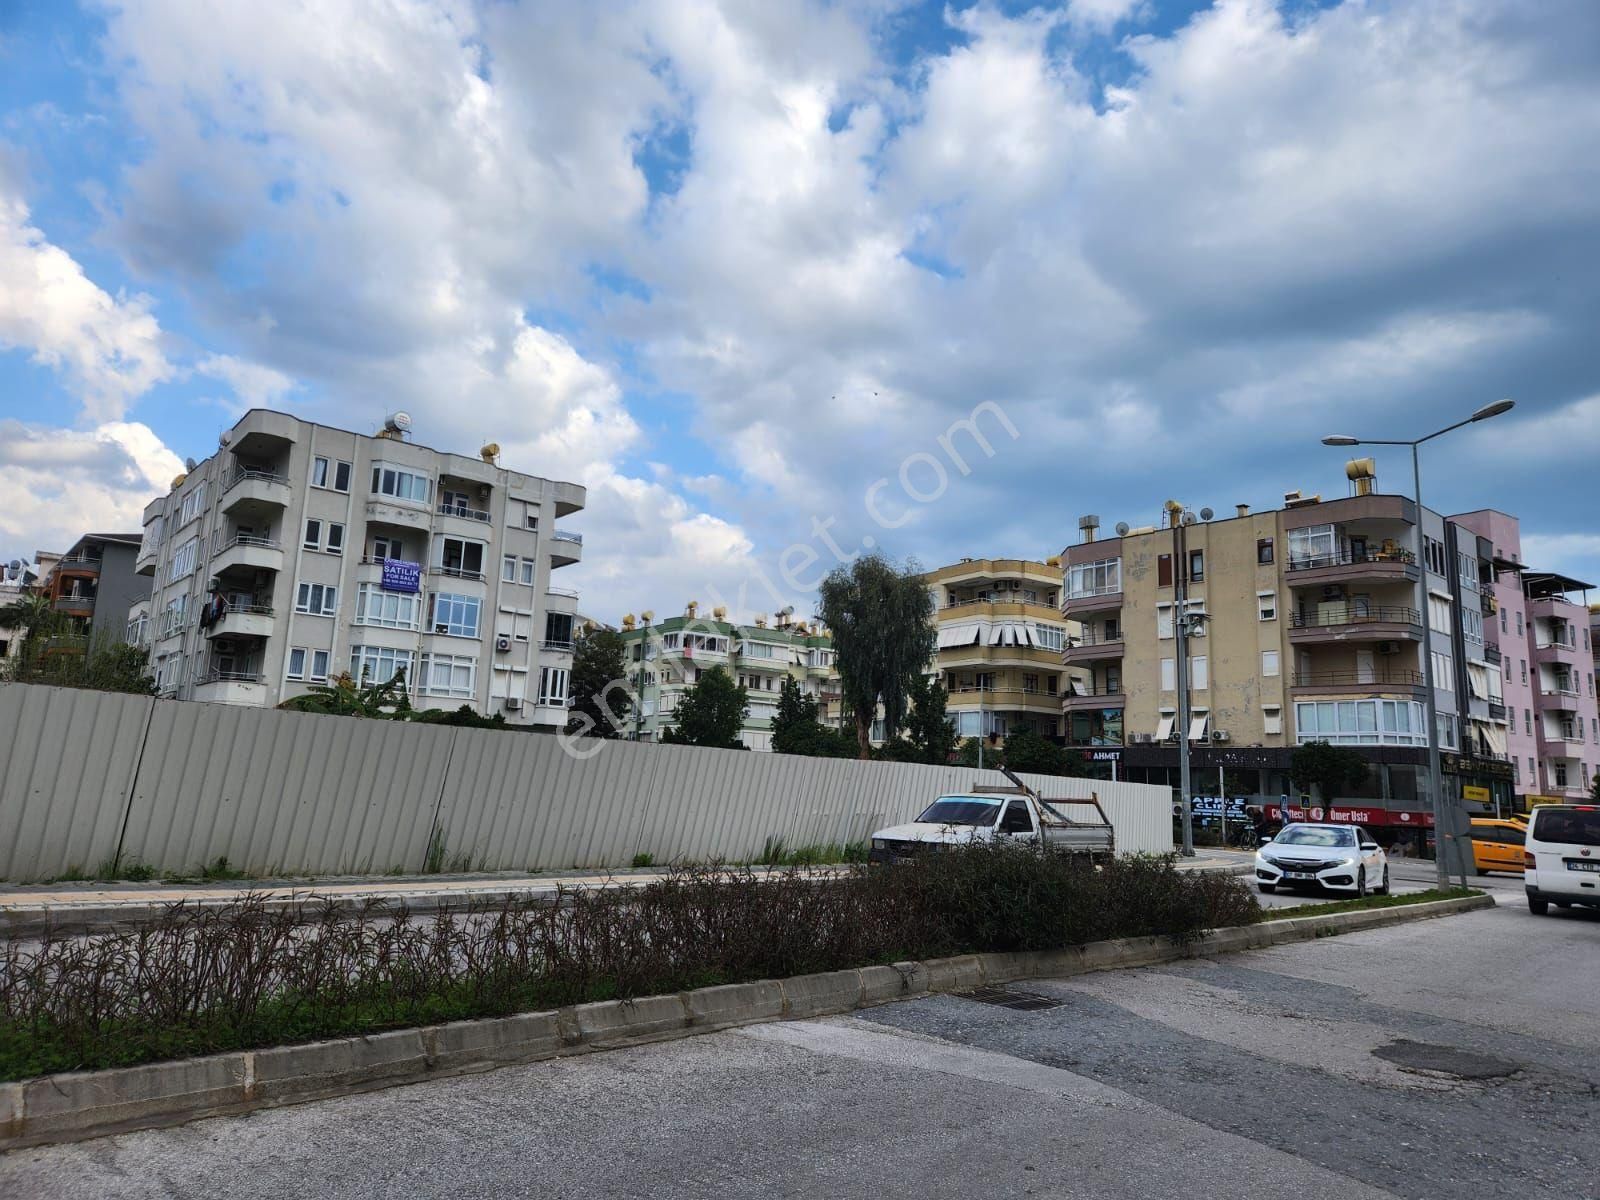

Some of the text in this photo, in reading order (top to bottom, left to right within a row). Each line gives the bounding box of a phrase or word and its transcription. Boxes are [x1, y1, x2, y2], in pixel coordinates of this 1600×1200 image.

[1093, 752, 1121, 760] AHMET
[1330, 808, 1369, 822] Ömer Usta
